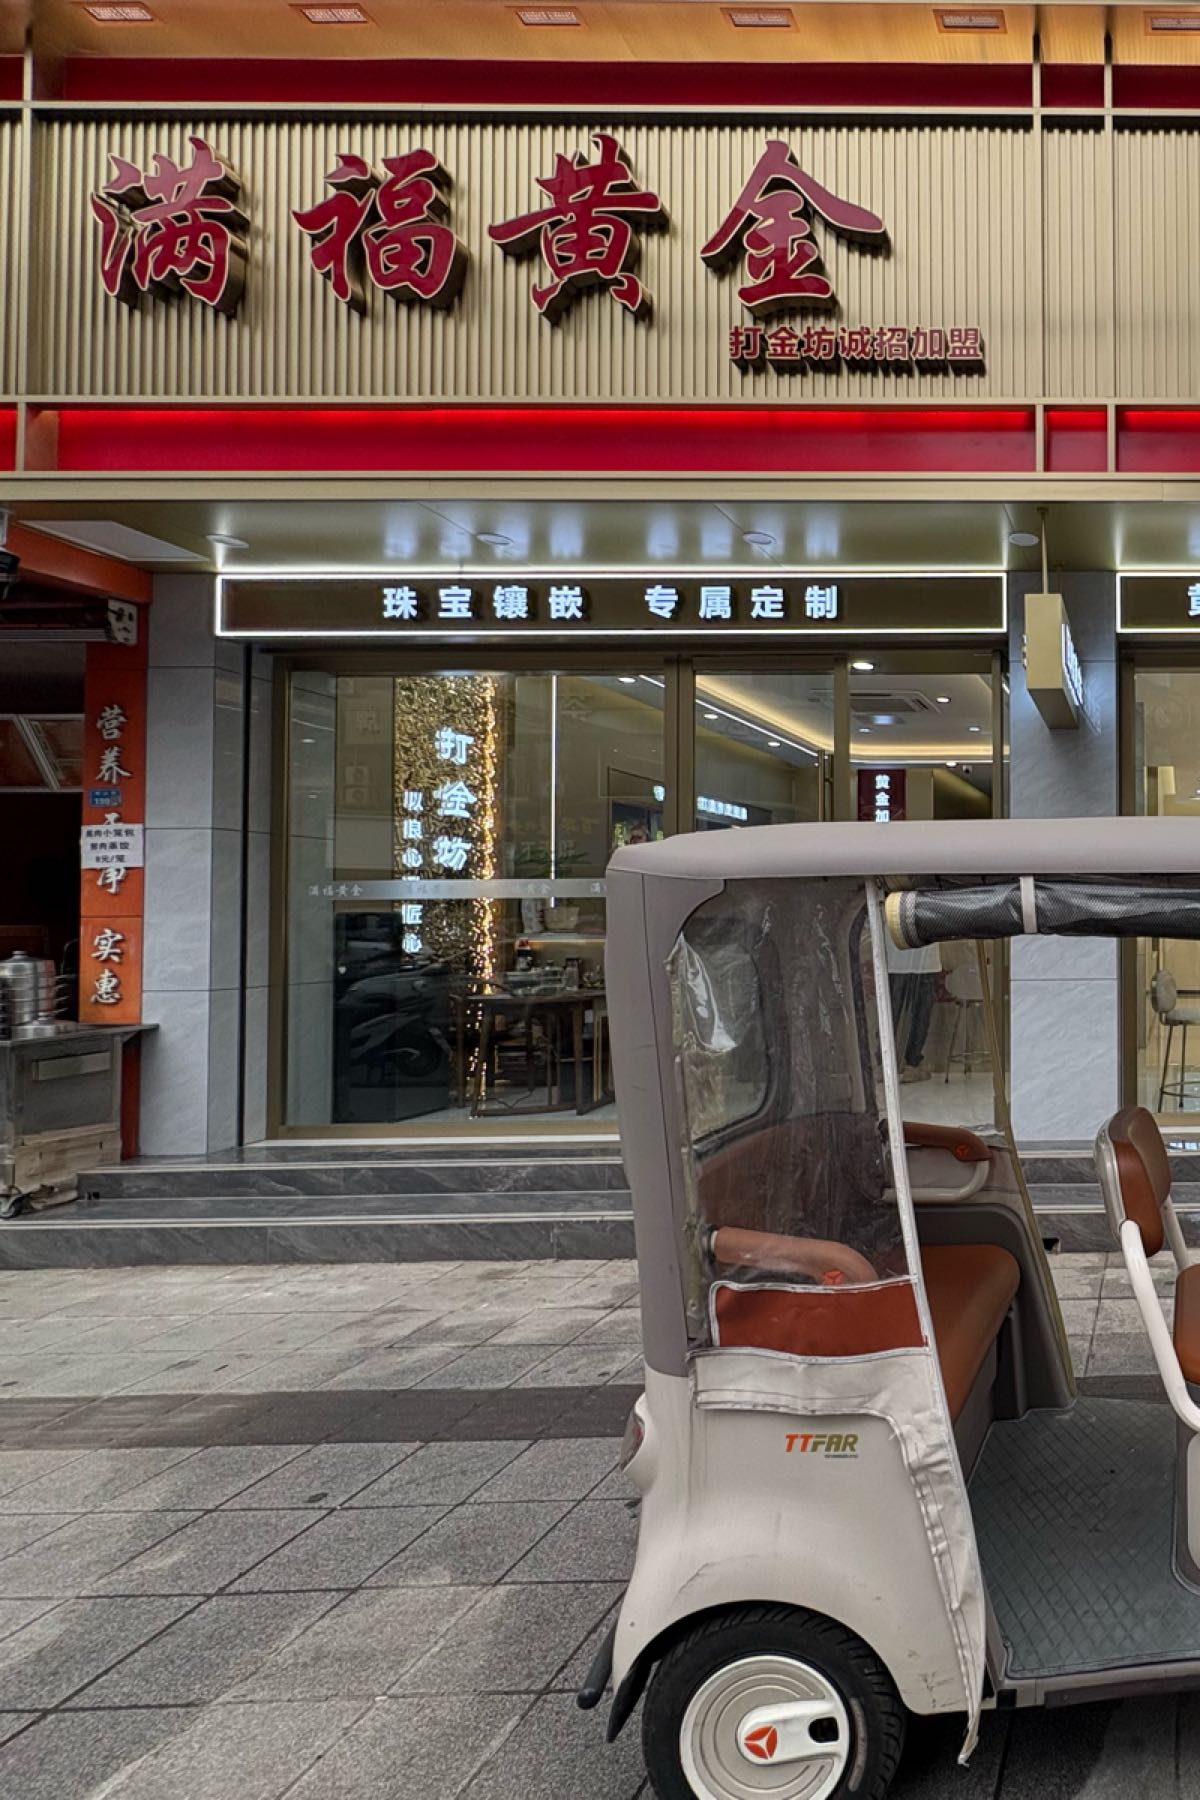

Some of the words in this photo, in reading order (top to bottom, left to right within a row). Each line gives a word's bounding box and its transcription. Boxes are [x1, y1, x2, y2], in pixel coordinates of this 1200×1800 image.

[91, 132, 888, 312] 满福黄金
[729, 325, 982, 361] 打金坊诚招加盟
[382, 585, 584, 620] 珠宝镶嵌
[645, 585, 840, 620] 专属定制
[95, 704, 132, 784] 营养
[432, 727, 477, 871] 打金坊
[401, 790, 424, 954] 以良心匠心
[90, 927, 124, 1004] 实惠
[784, 1433, 859, 1453] TTFAR
